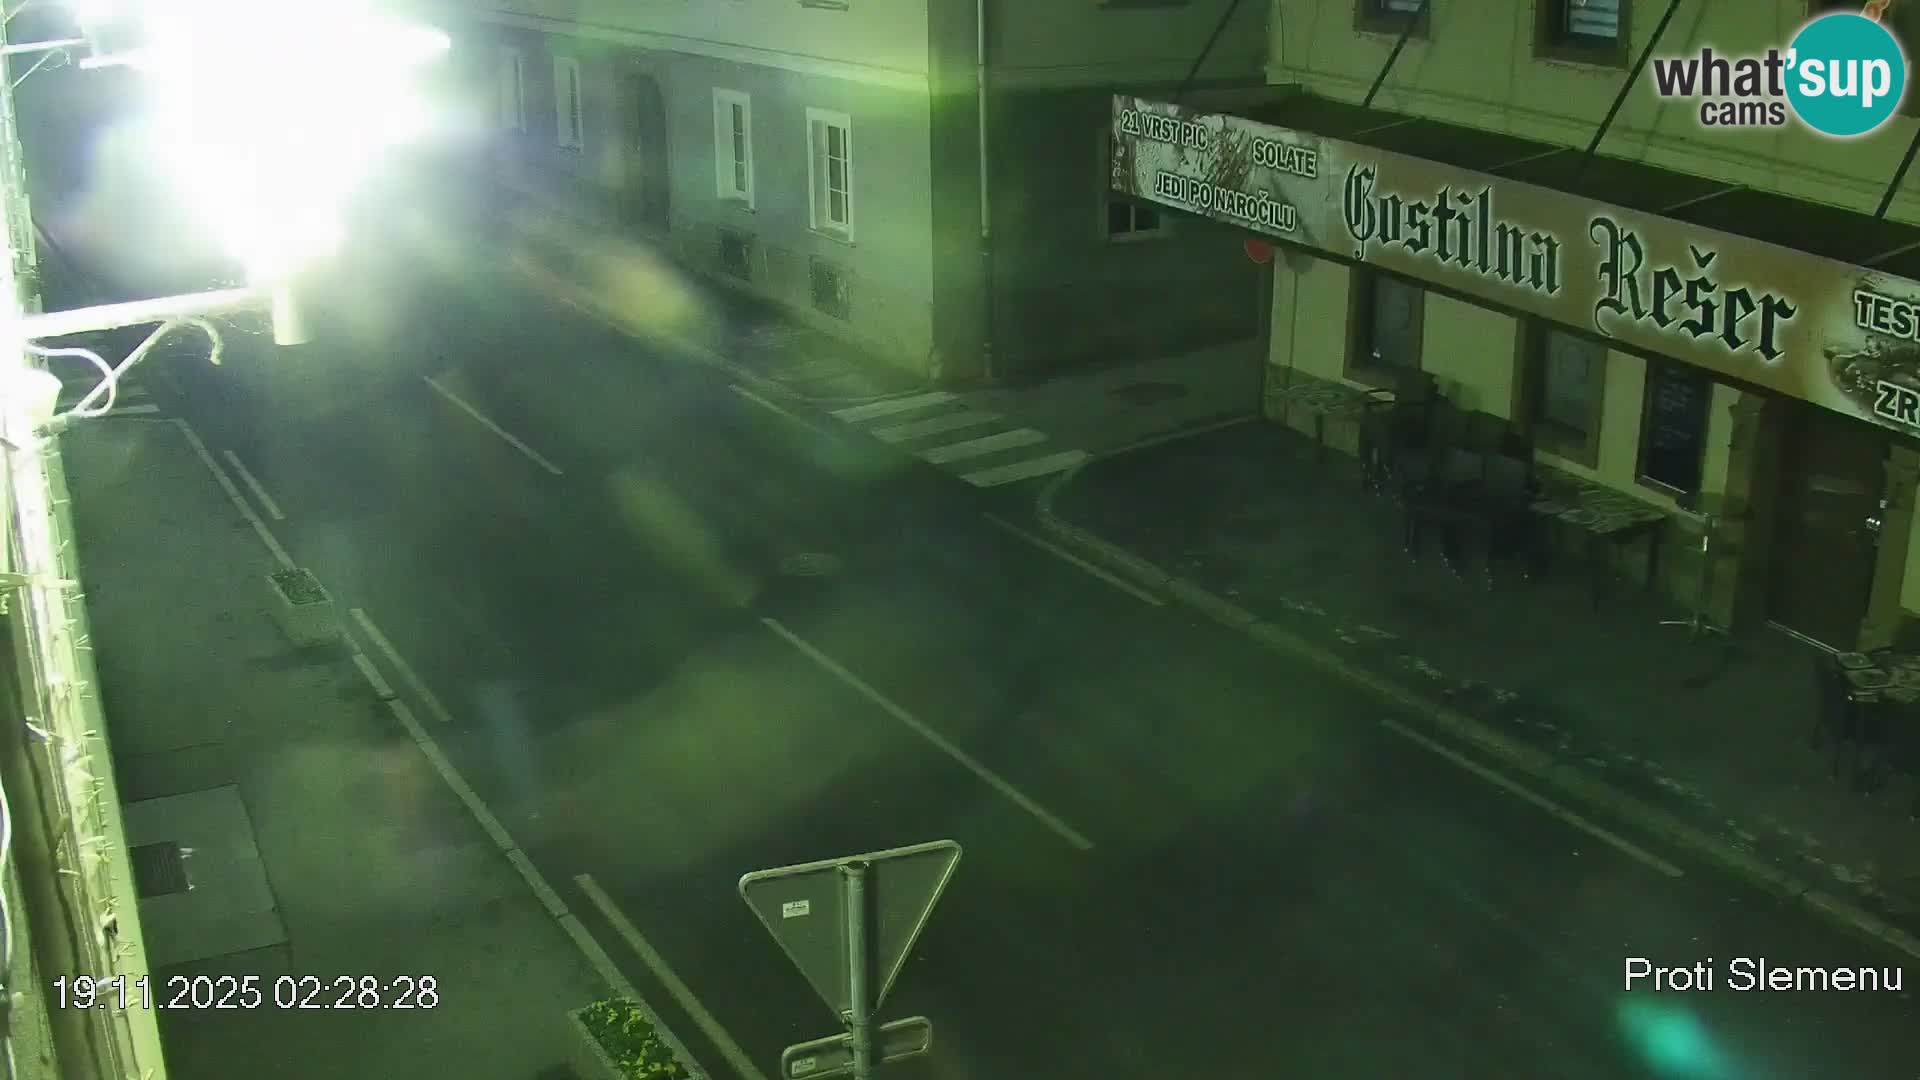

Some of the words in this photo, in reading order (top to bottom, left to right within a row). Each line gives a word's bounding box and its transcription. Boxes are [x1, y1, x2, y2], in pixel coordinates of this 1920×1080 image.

[1121, 109, 1140, 135] 21
[1141, 112, 1180, 144] VRST
[1181, 122, 1208, 150] PIC
[1252, 139, 1317, 178] SOLATE
[1155, 171, 1186, 202] JEDI
[1188, 180, 1212, 206] PO
[1213, 187, 1297, 233] NAROČILU
[1345, 161, 1561, 295] Gostilna
[1590, 217, 1798, 361] Rešer
